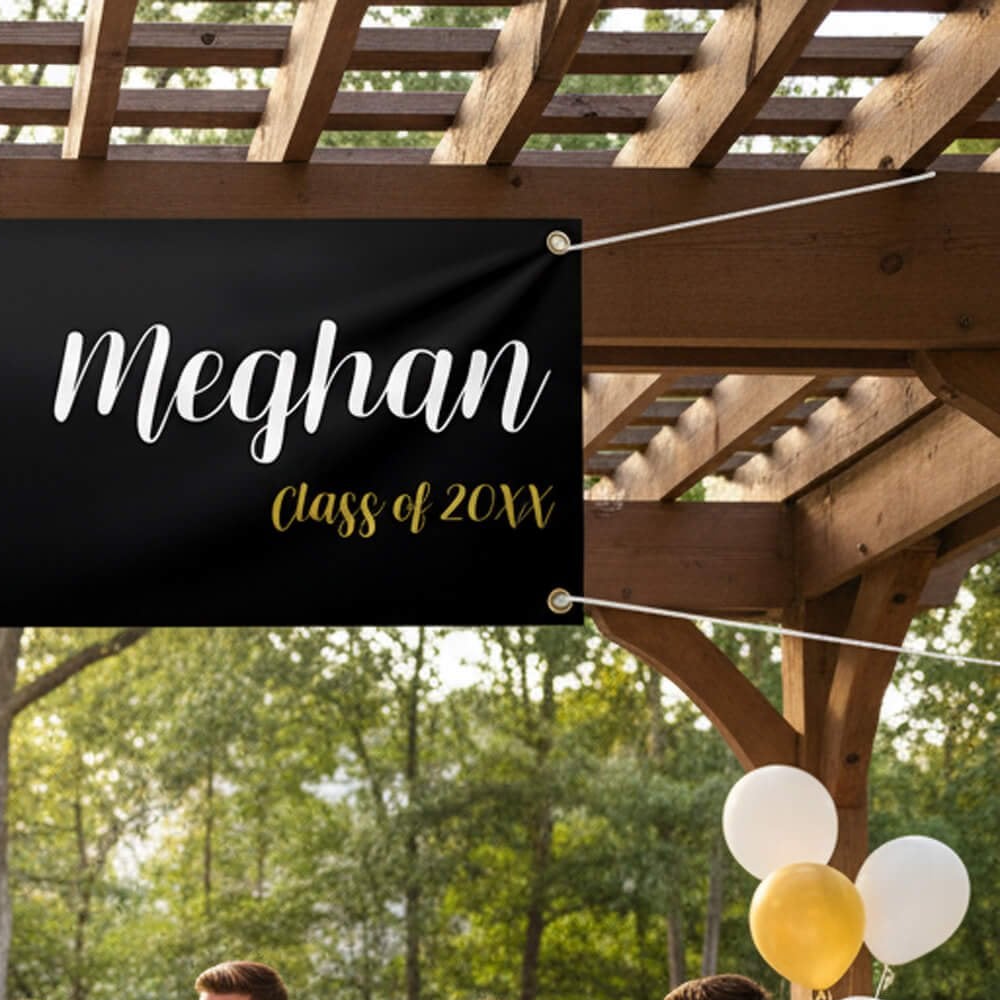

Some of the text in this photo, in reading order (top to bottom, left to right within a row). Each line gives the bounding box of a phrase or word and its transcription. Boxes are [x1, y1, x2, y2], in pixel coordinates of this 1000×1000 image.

[53, 319, 551, 464] Meghan
[271, 481, 555, 538] Class of 20XX
